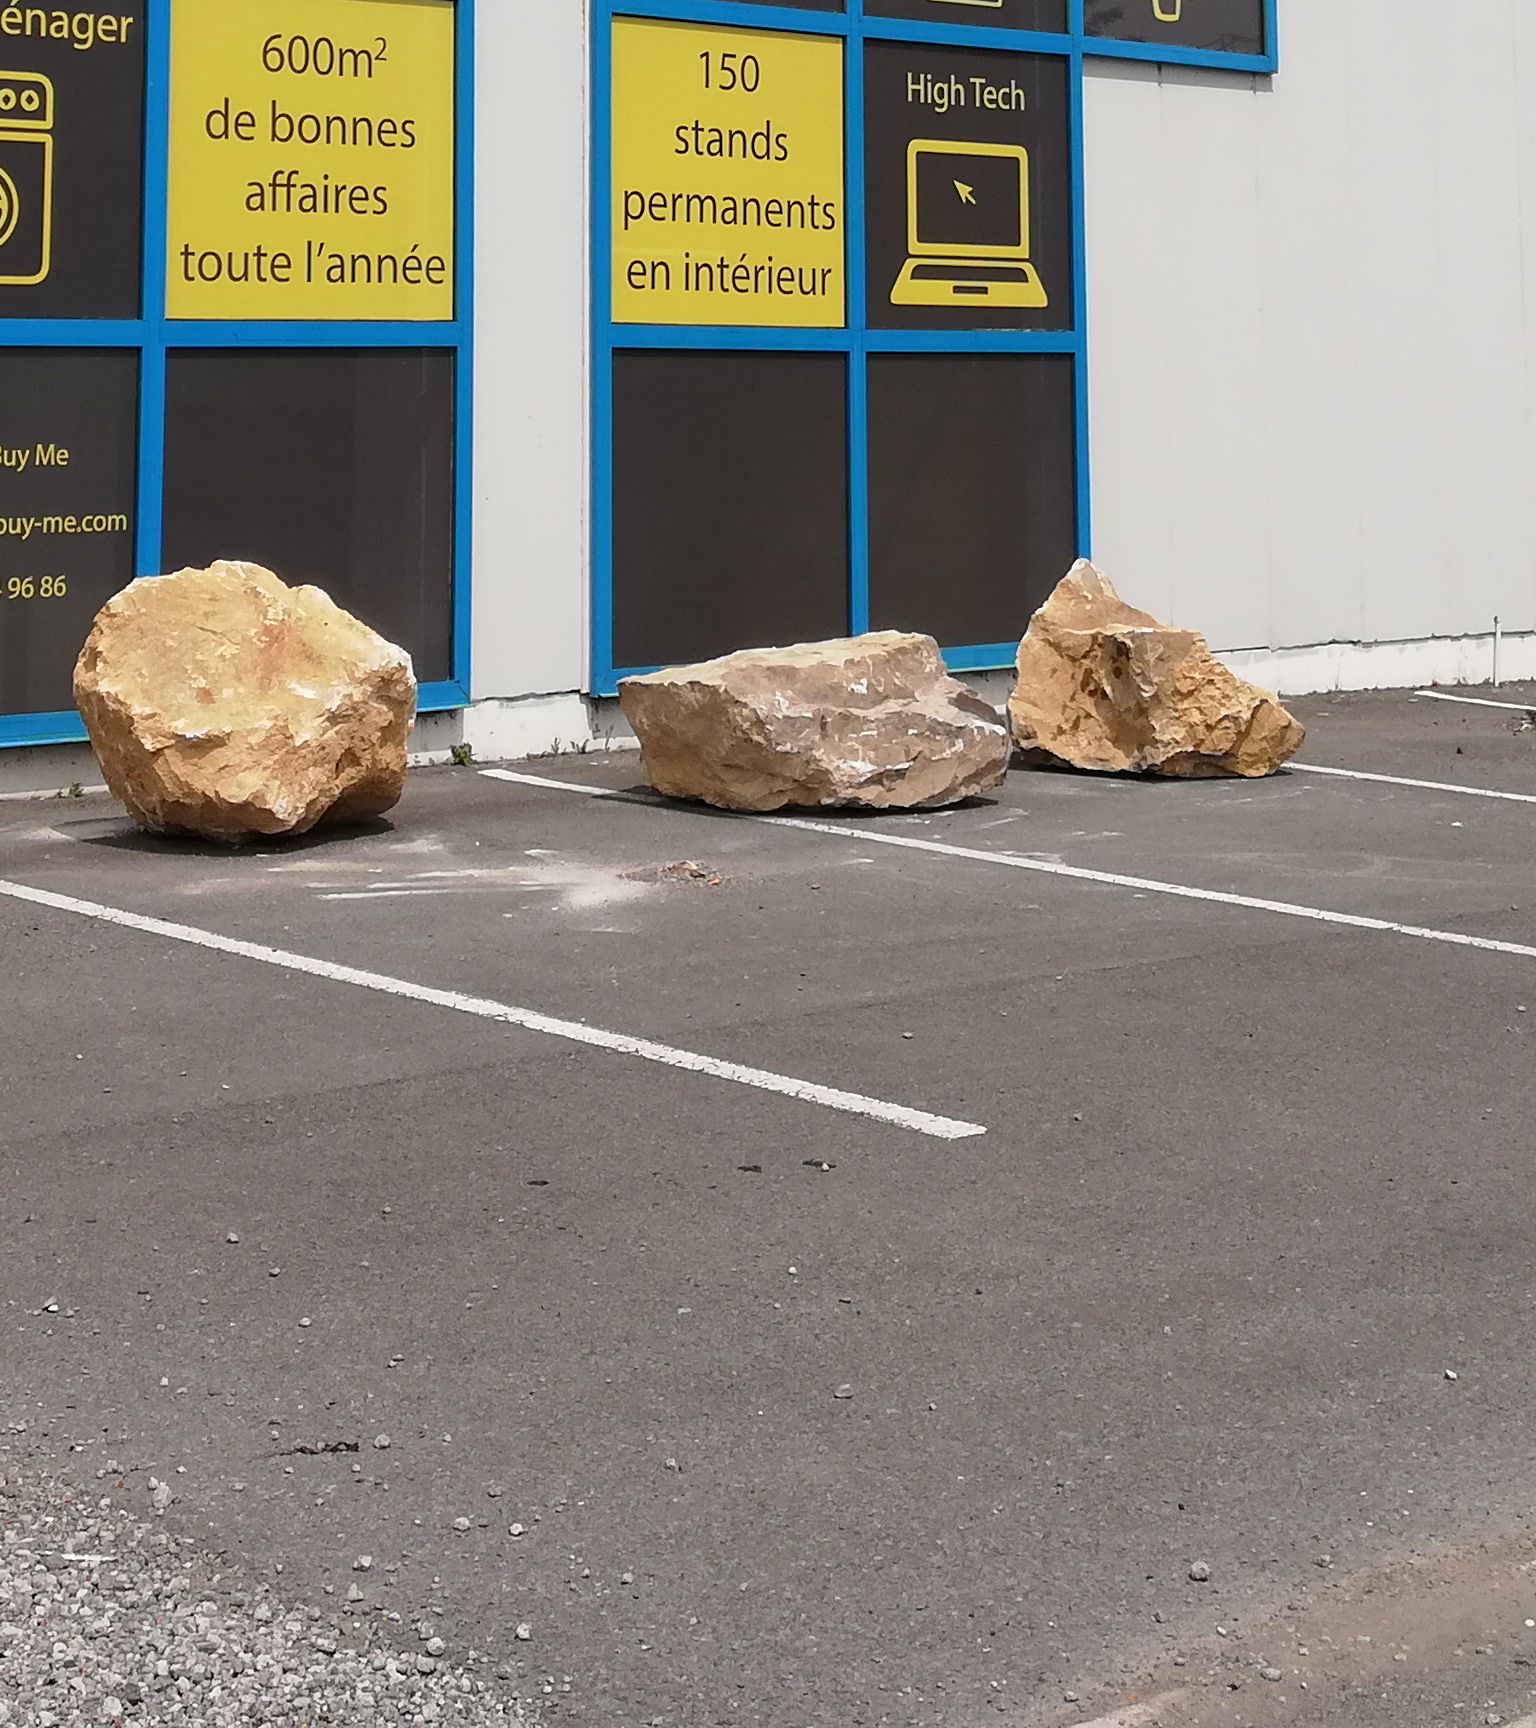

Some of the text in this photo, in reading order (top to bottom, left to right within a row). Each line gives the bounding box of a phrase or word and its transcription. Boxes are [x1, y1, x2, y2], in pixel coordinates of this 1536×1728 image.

[699, 51, 760, 93] 150
[907, 71, 1025, 113] High Tech
[205, 96, 416, 148] de bonnes
[674, 119, 788, 162] stands
[245, 169, 388, 215] affaires
[623, 190, 836, 231] permanents
[179, 241, 449, 286] toute l'année
[627, 251, 832, 296] en intérieur
[35, 443, 69, 466] Me
[7, 575, 35, 599] 96
[39, 574, 67, 598] 86
